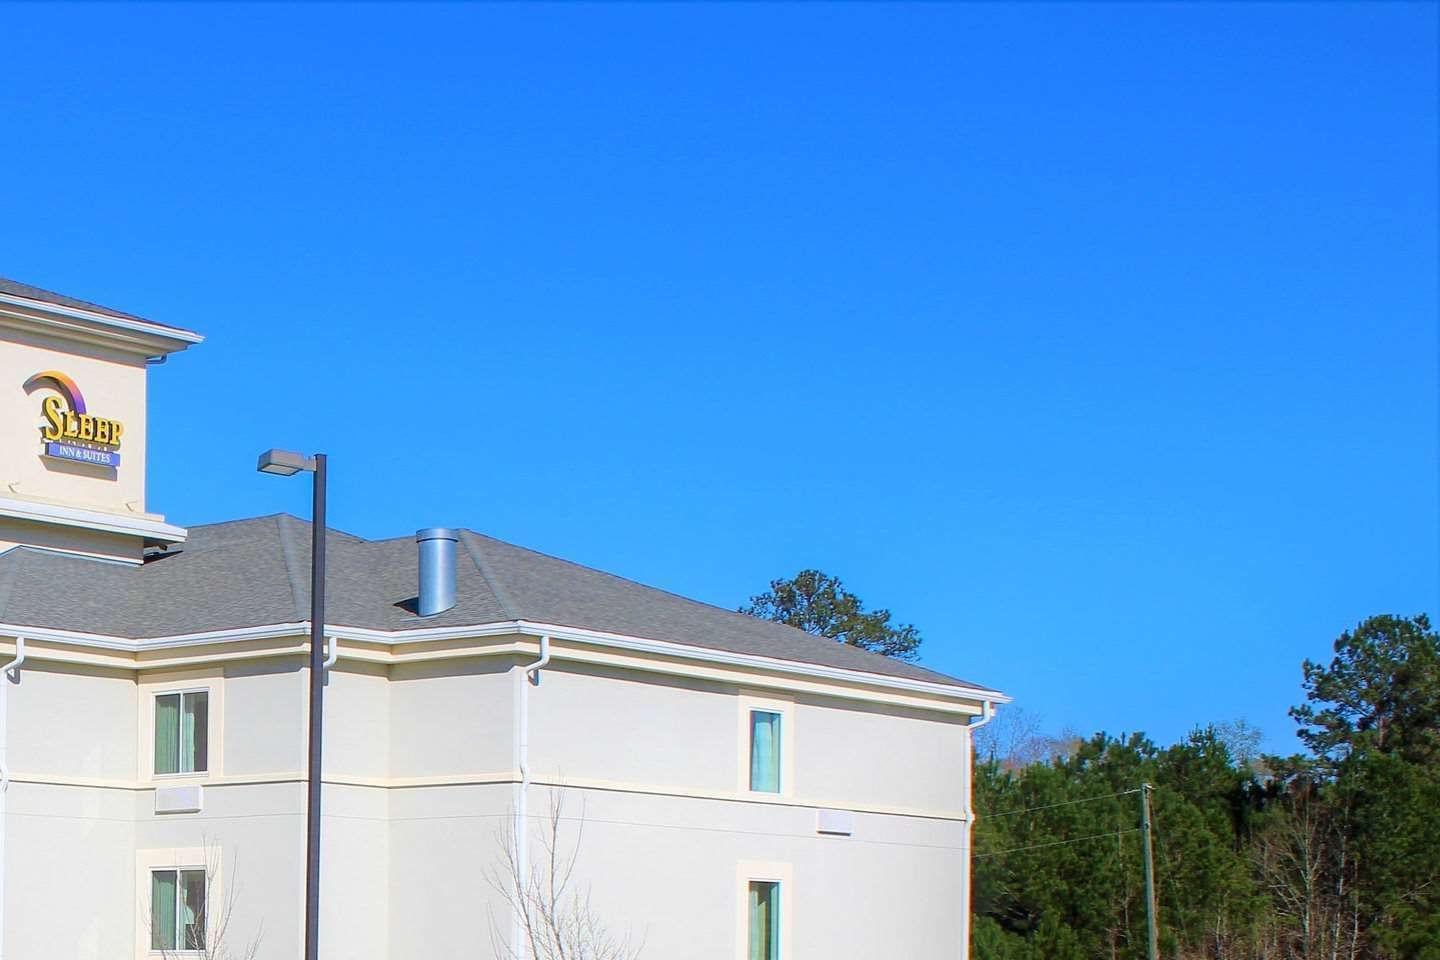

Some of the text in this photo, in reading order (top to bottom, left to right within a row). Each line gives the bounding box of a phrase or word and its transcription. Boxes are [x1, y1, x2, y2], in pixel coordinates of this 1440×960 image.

[44, 396, 124, 446] SLEEP
[60, 445, 111, 463] INN & SUITES
